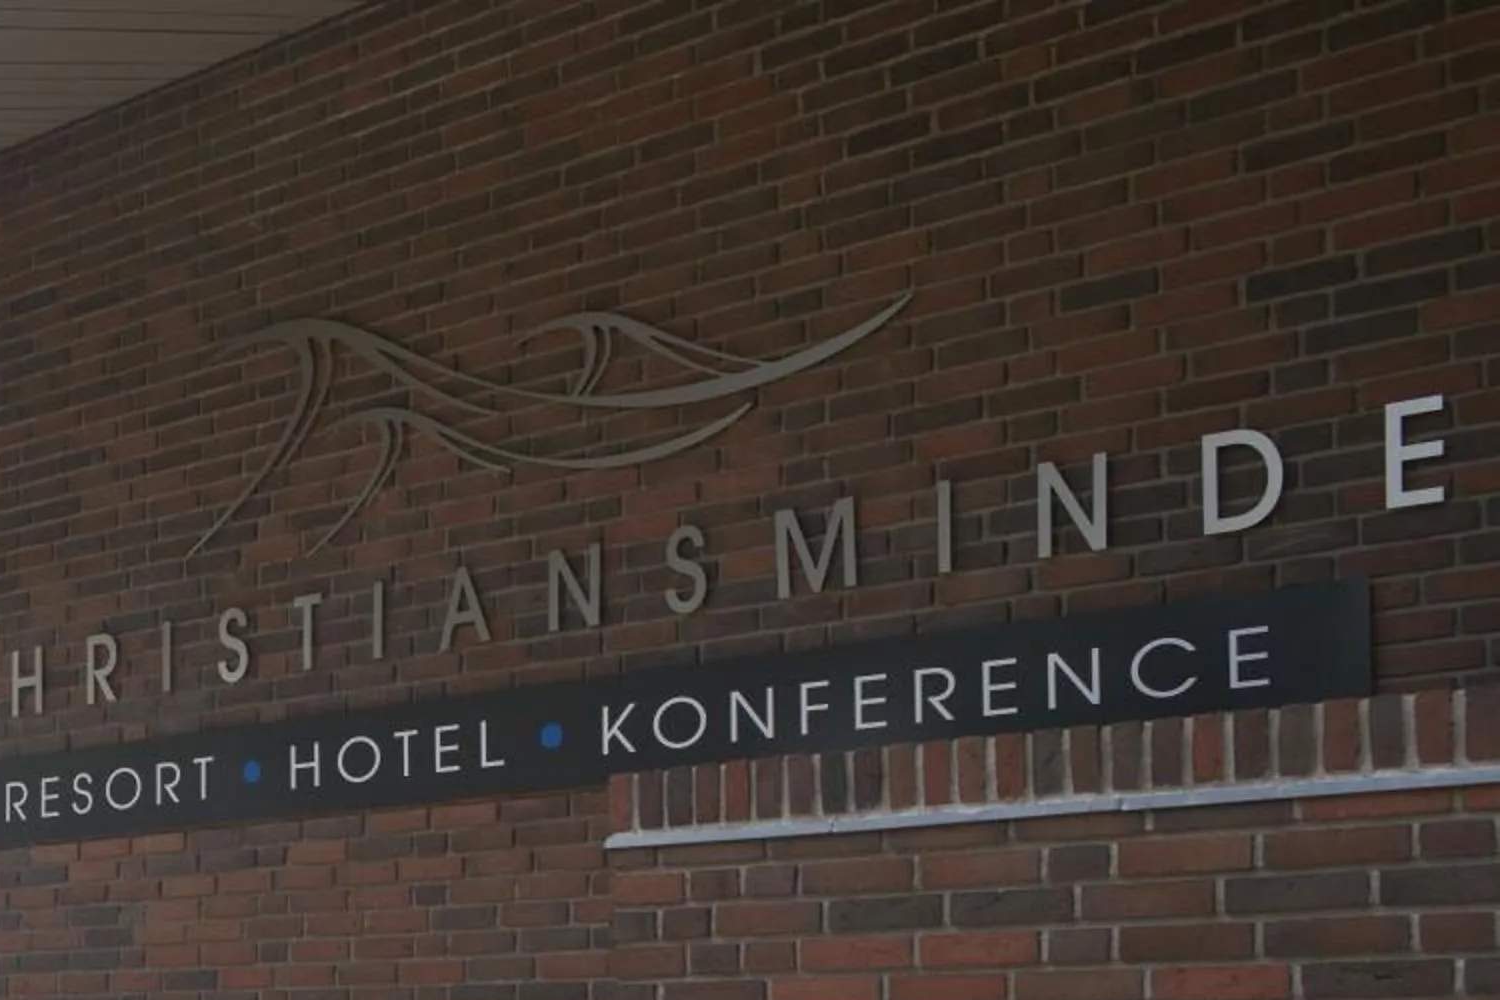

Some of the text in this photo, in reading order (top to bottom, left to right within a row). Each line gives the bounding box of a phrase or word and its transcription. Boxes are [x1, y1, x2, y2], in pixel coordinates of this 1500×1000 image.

[4, 625, 1272, 823] RESORT HOTEL KONFERENCE
